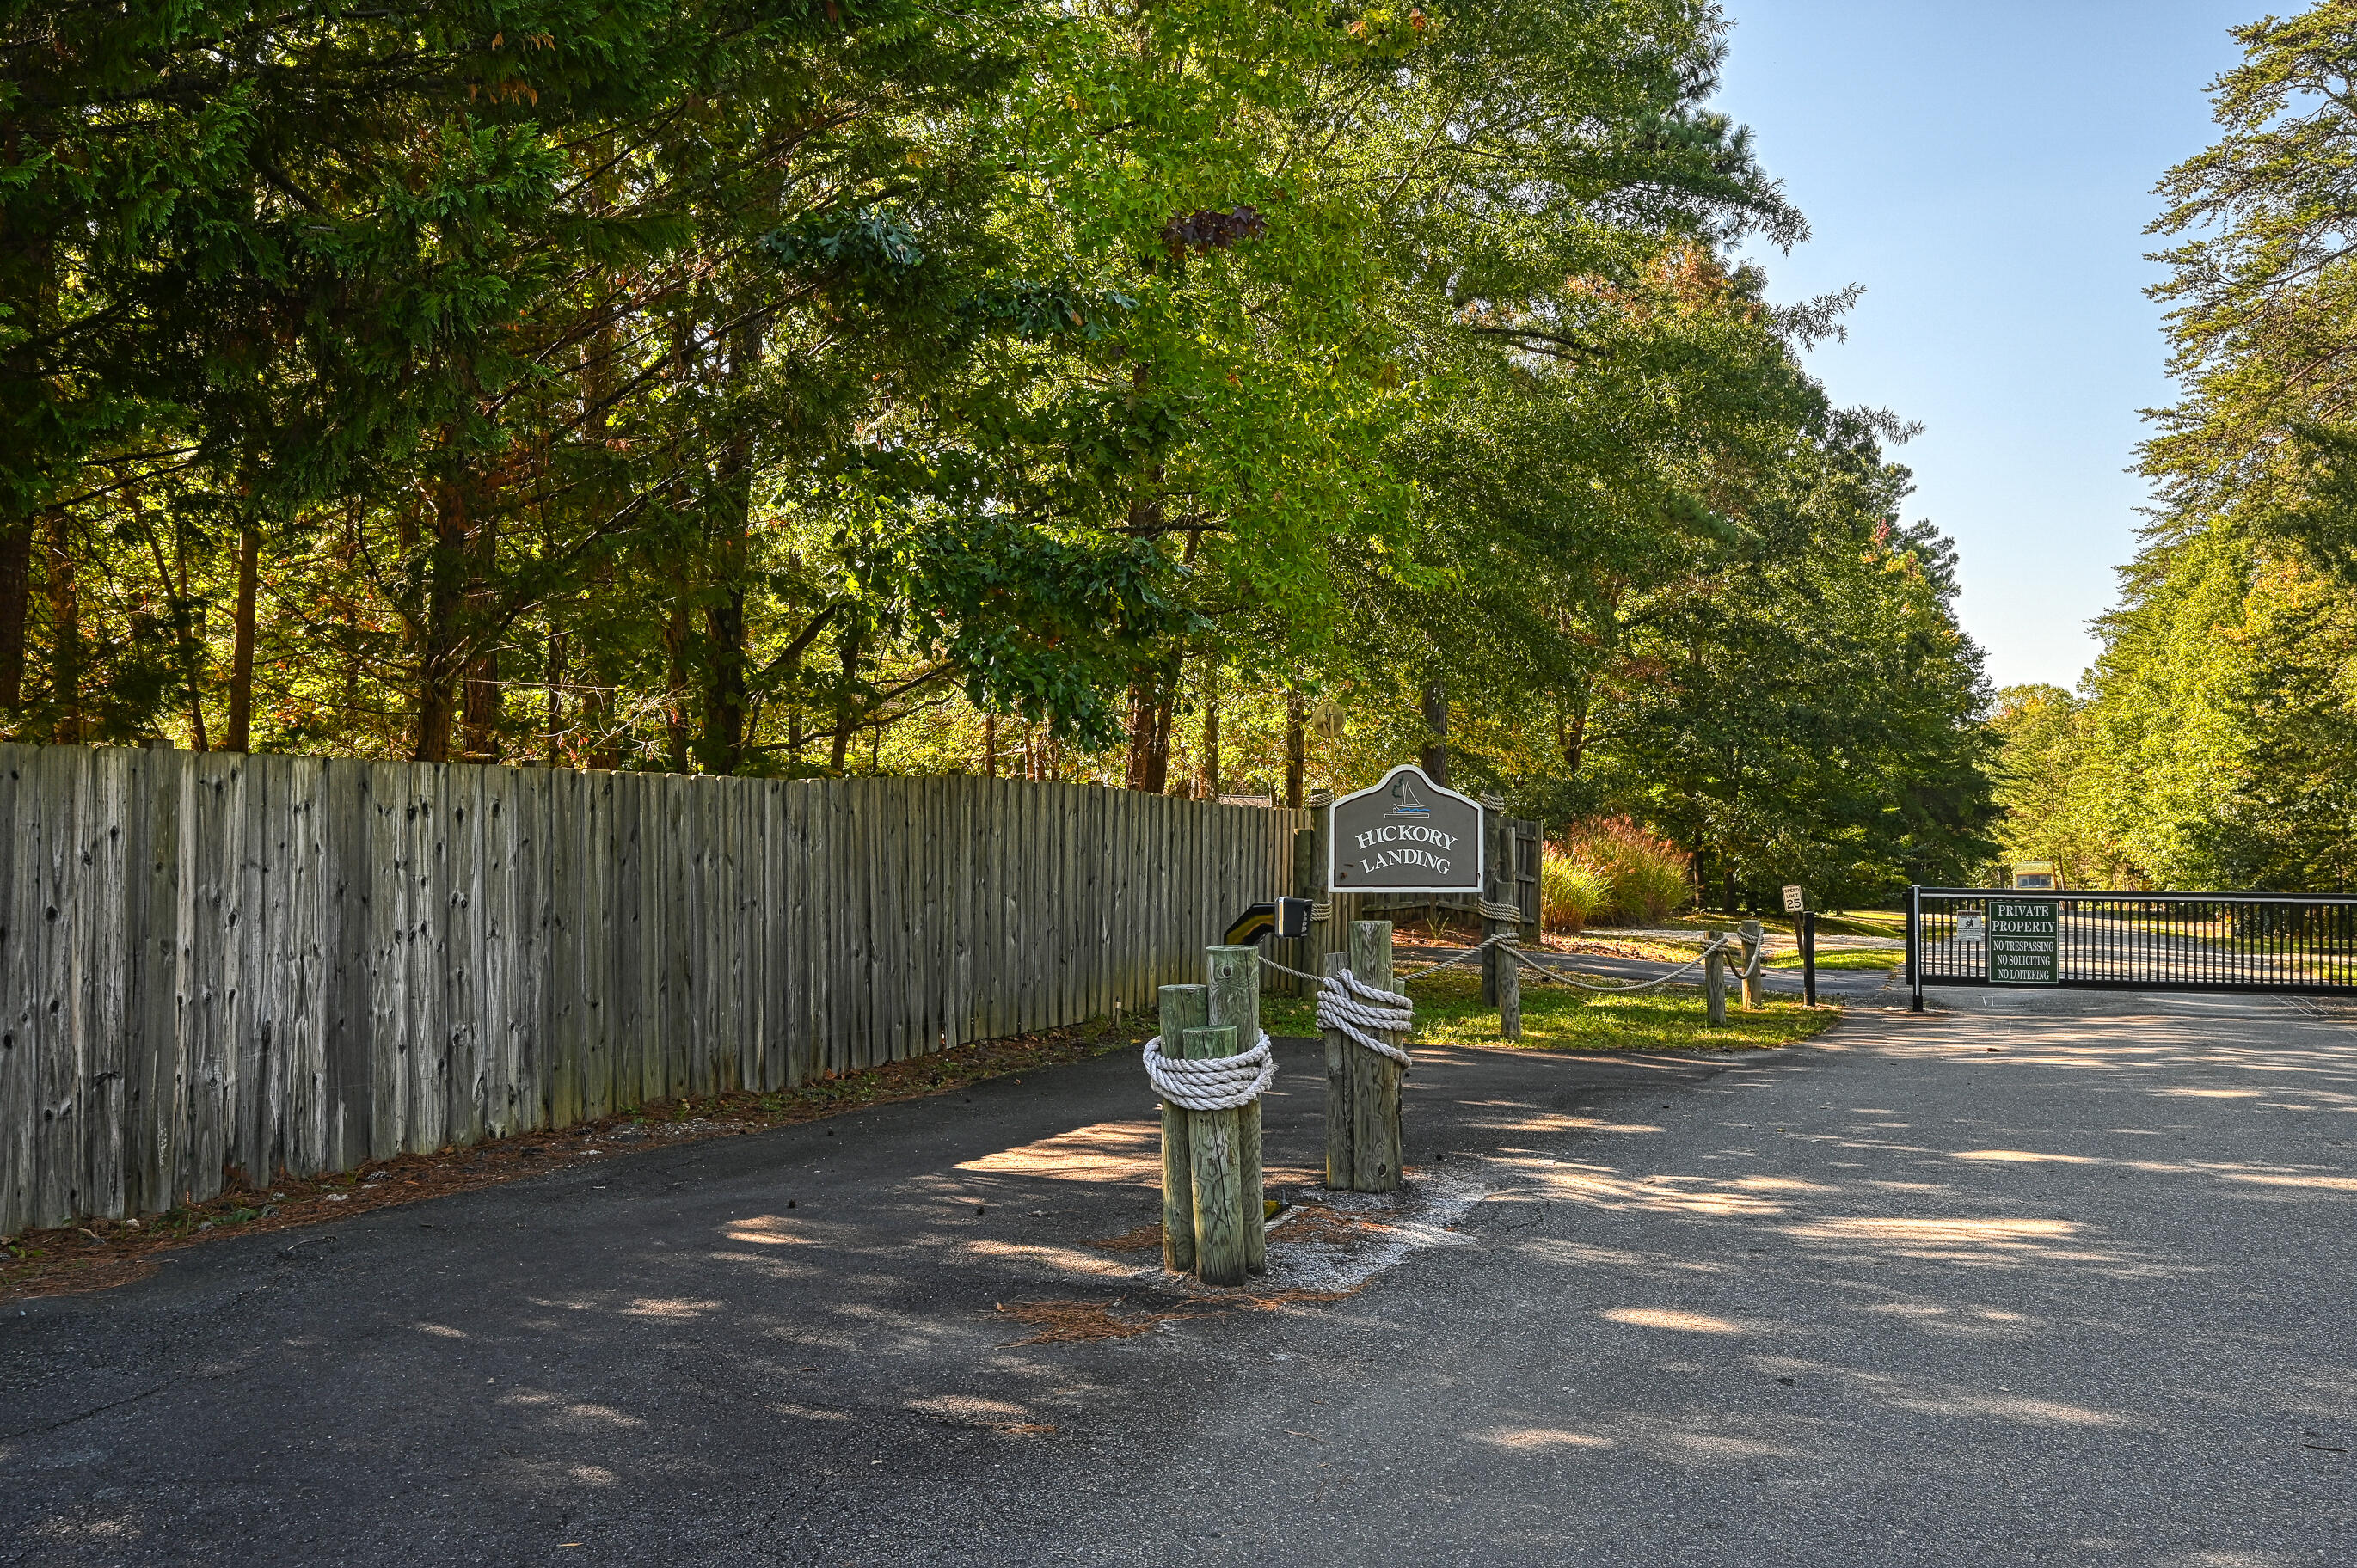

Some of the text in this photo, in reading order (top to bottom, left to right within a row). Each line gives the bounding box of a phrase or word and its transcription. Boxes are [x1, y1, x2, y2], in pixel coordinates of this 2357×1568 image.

[1354, 824, 1458, 851] HICKORY
[1360, 848, 1451, 875] LANDING
[1786, 898, 1802, 909] 25
[1998, 904, 2049, 917] PRIVATE
[1992, 920, 2055, 933] PROPERTY
[1993, 940, 2054, 952] NO TRESPASSING
[1997, 954, 2051, 966] NO SOLICITING
[1998, 968, 2050, 980] NO LOITERING
